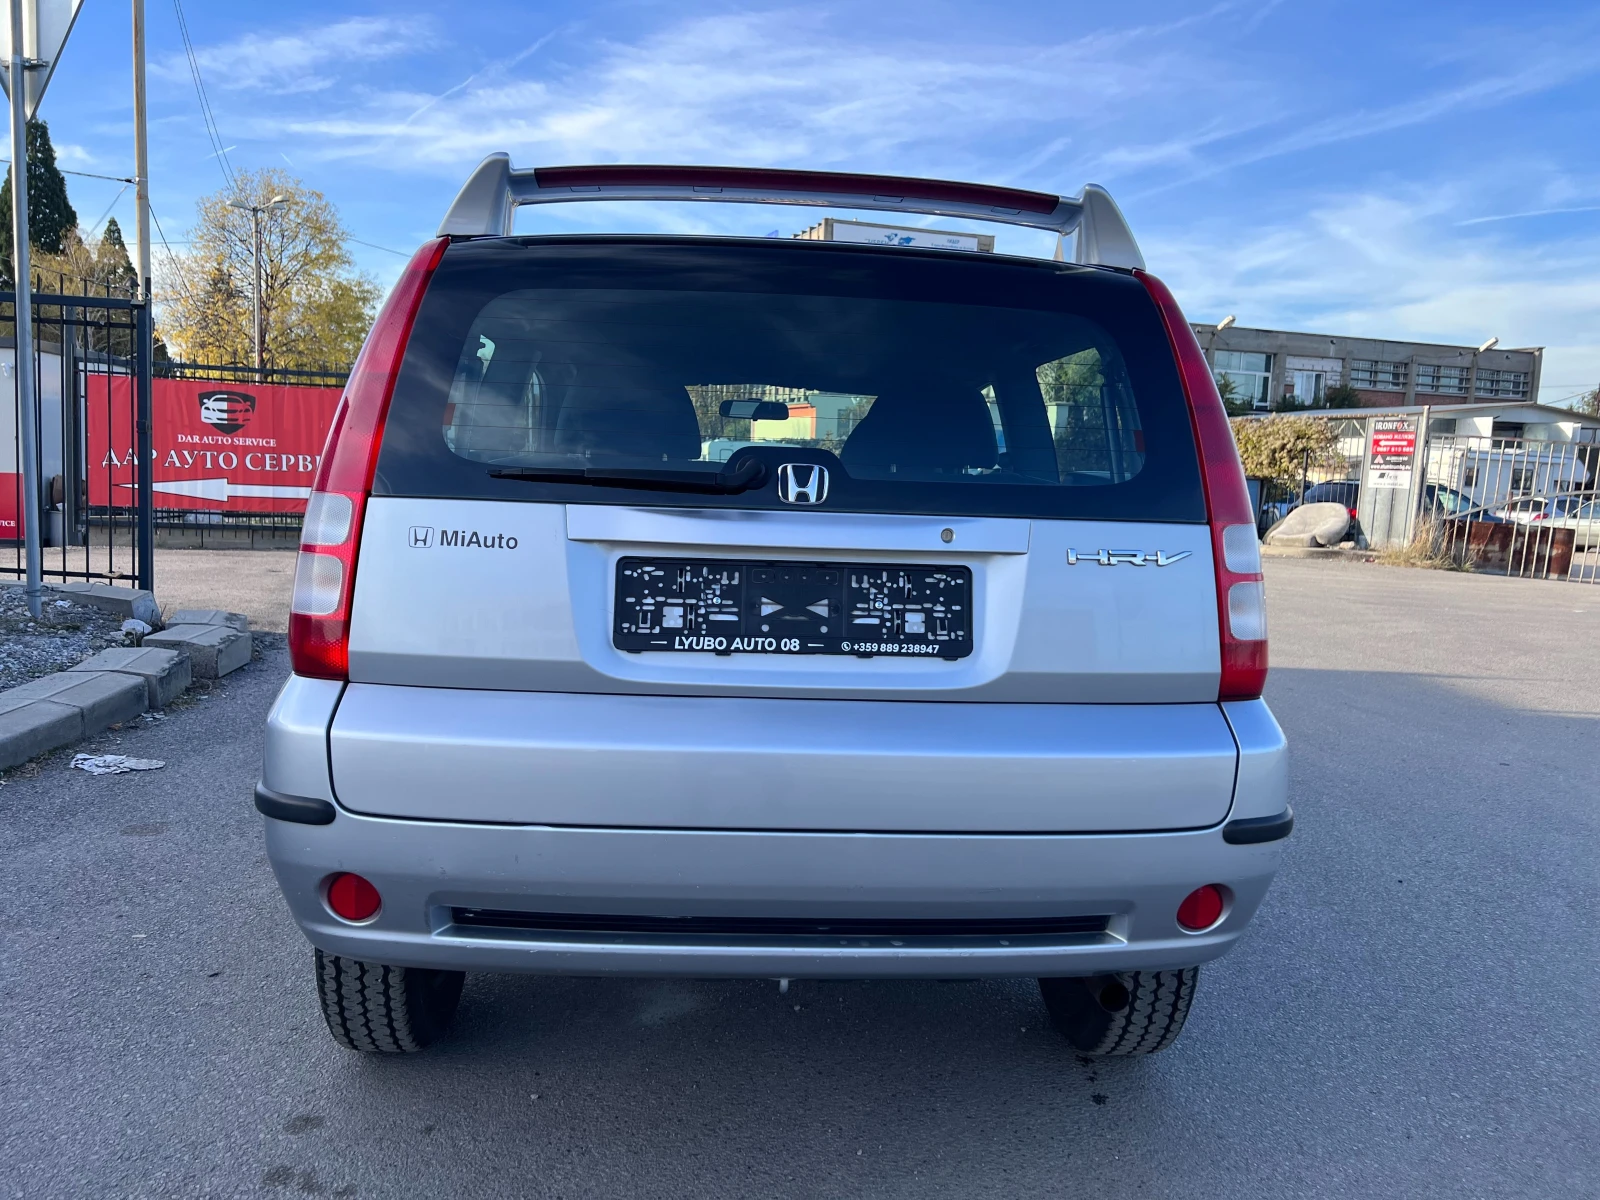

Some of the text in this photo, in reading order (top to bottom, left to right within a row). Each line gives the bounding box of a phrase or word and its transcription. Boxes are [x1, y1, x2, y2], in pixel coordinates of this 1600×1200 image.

[177, 434, 277, 447] DAR AUTO SERVICE
[163, 449, 238, 470] АУТО
[440, 529, 518, 549] MiAuto
[1066, 547, 1193, 567] HR-V
[674, 636, 800, 651] LYUBO AUTO 08
[853, 642, 939, 654] +359 889 238947
